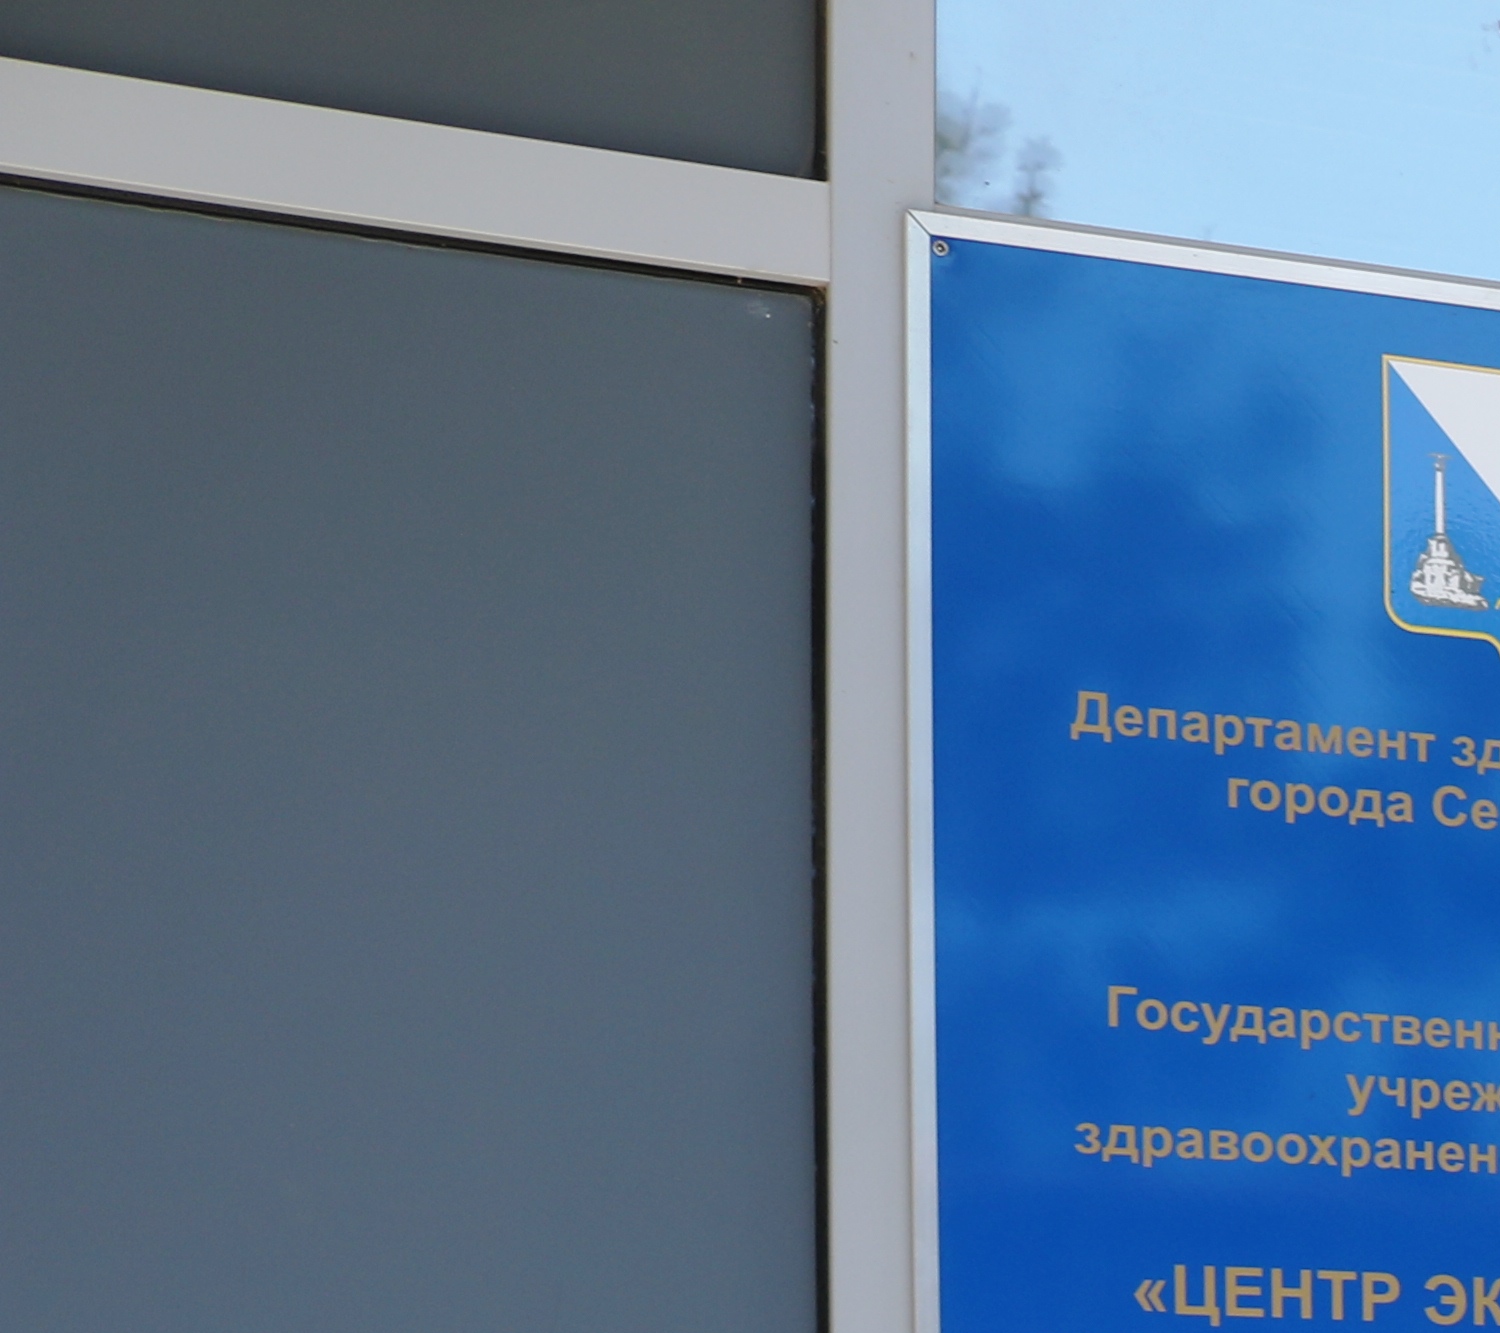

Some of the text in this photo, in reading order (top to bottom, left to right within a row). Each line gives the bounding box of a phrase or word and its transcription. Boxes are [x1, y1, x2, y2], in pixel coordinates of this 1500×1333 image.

[1070, 690, 1437, 763] Департамент
[1226, 773, 1414, 828] города
[1134, 1264, 1402, 1328] «ЦЕНТР
